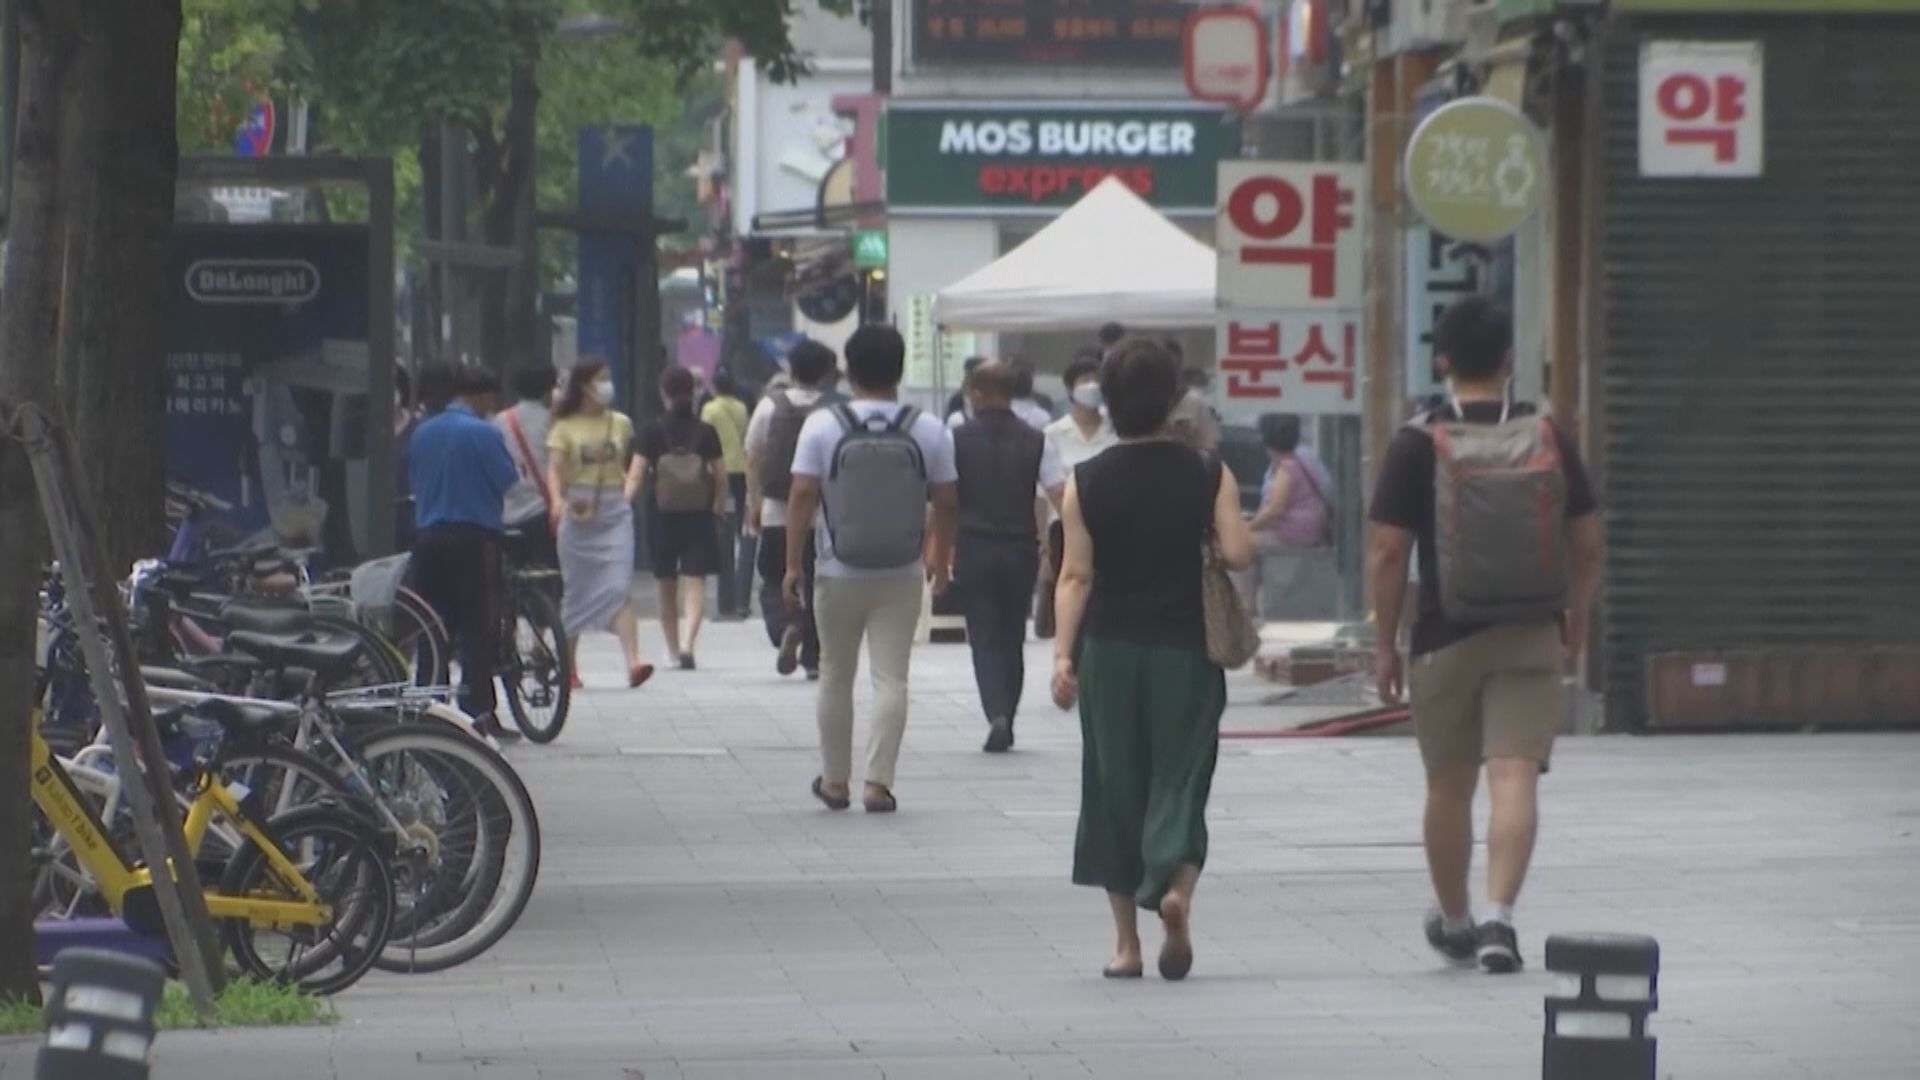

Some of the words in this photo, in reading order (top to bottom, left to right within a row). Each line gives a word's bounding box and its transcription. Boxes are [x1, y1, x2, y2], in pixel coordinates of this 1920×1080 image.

[939, 120, 1032, 153] MOS
[1038, 119, 1195, 154] BURGER
[1657, 73, 1747, 163] 약
[1228, 174, 1355, 298] 약
[1221, 321, 1355, 400] 분식
